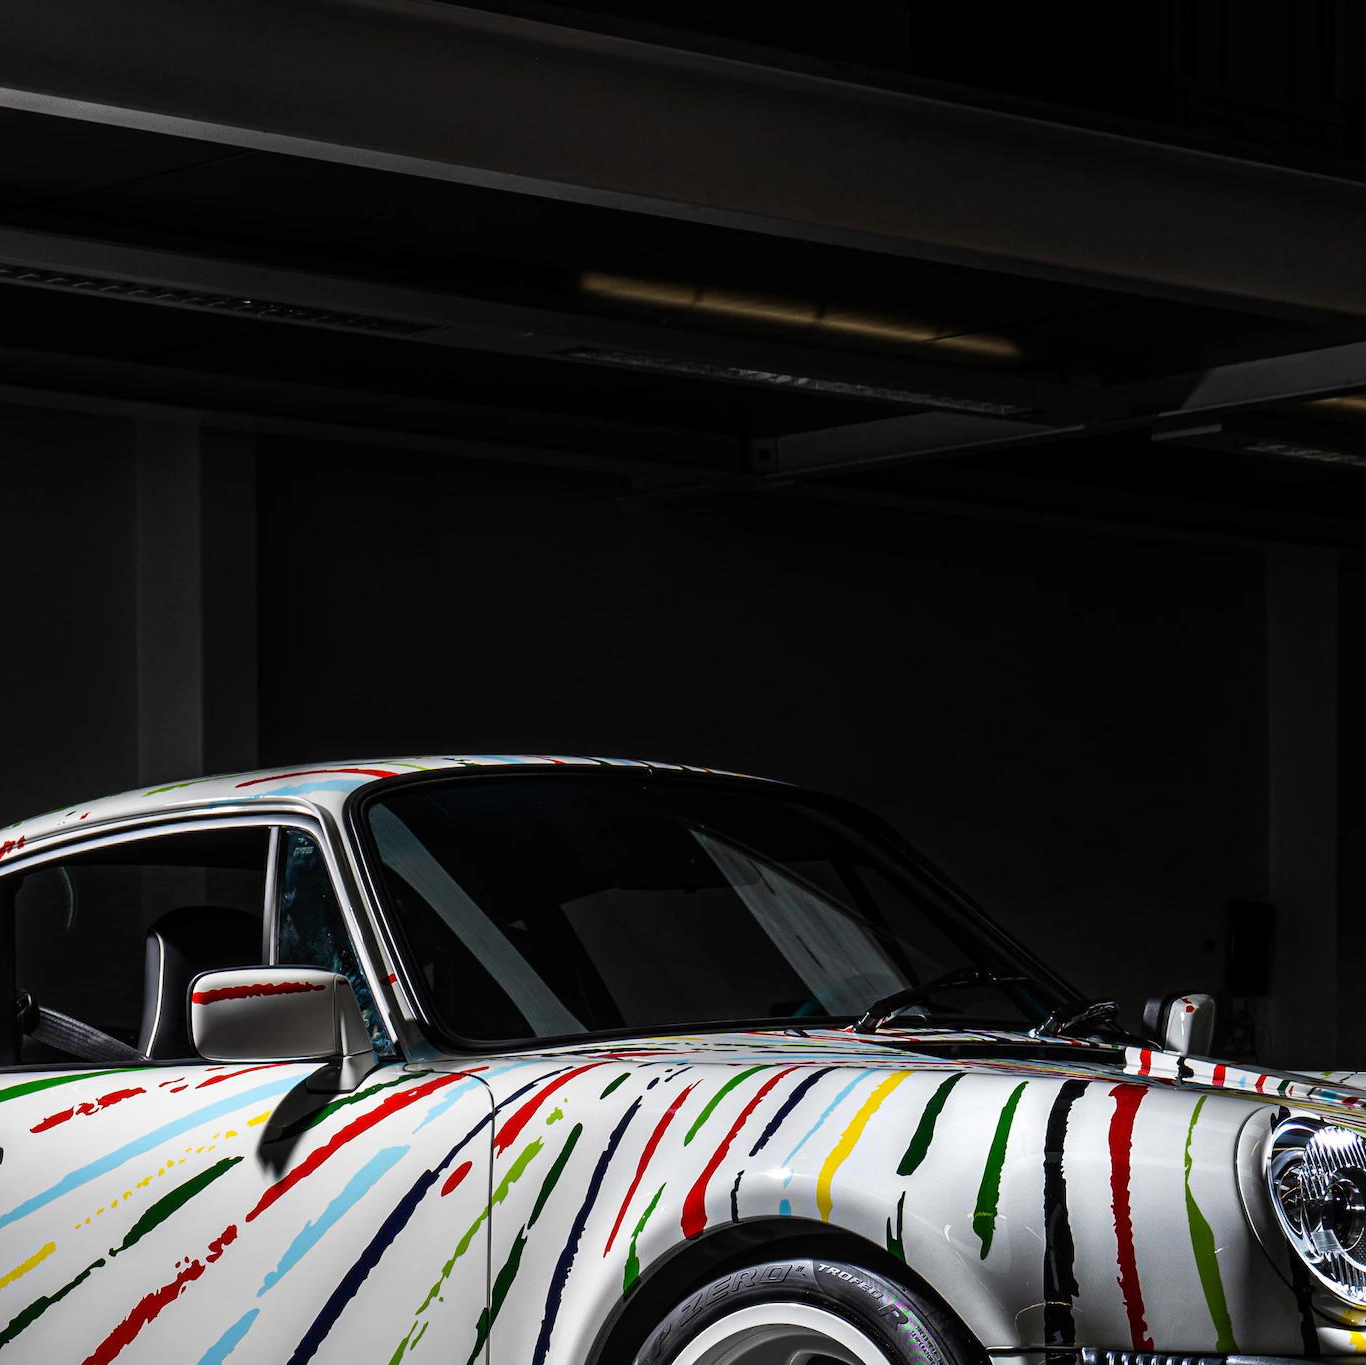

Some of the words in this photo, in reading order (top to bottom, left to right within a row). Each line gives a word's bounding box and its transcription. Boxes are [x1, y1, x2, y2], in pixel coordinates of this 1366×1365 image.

[654, 1322, 672, 1360] P
[680, 1264, 793, 1327] ZERO
[818, 1263, 883, 1300] TROFEO
[878, 1303, 909, 1331] R
